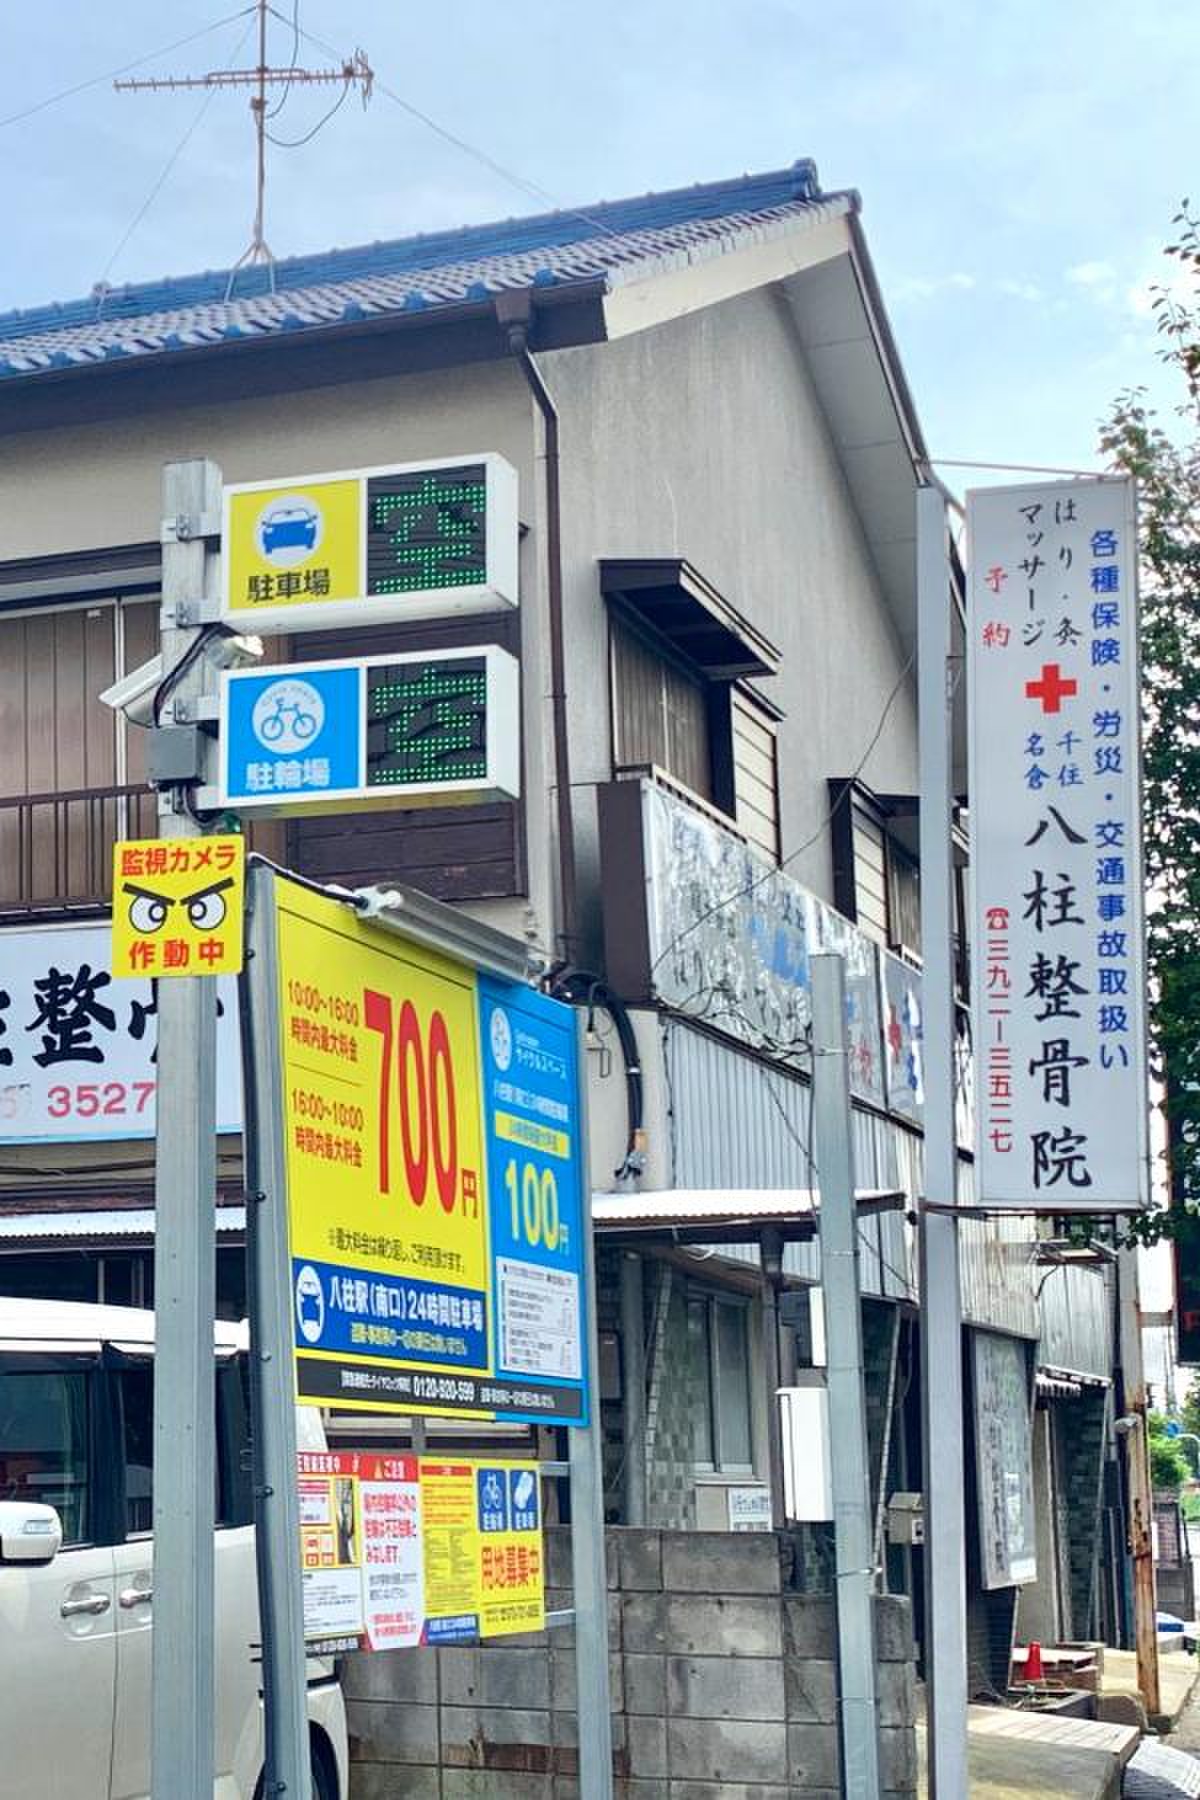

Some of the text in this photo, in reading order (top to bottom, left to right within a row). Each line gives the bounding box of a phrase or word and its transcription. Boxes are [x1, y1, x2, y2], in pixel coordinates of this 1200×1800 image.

[374, 477, 486, 593] 空
[247, 568, 330, 602] 駐車場
[1018, 503, 1046, 647] マッサージ
[1053, 498, 1083, 647] はり・灸
[982, 566, 1011, 648] 予約
[374, 667, 486, 783] 空
[245, 759, 331, 791] 駐輪場
[1023, 731, 1051, 790] 名倉
[1056, 730, 1085, 788] 千住
[1089, 529, 1129, 1070] 各種保険・労災・交通事故取扱い
[121, 844, 236, 876] 監視カメラ
[129, 939, 225, 970] 作動中
[1022, 804, 1093, 1190] 八柱整骨院
[291, 1016, 358, 1063] 時間内最大料金
[295, 1125, 363, 1168] 時間内最大料金
[481, 1545, 541, 1592] 用地募集中
